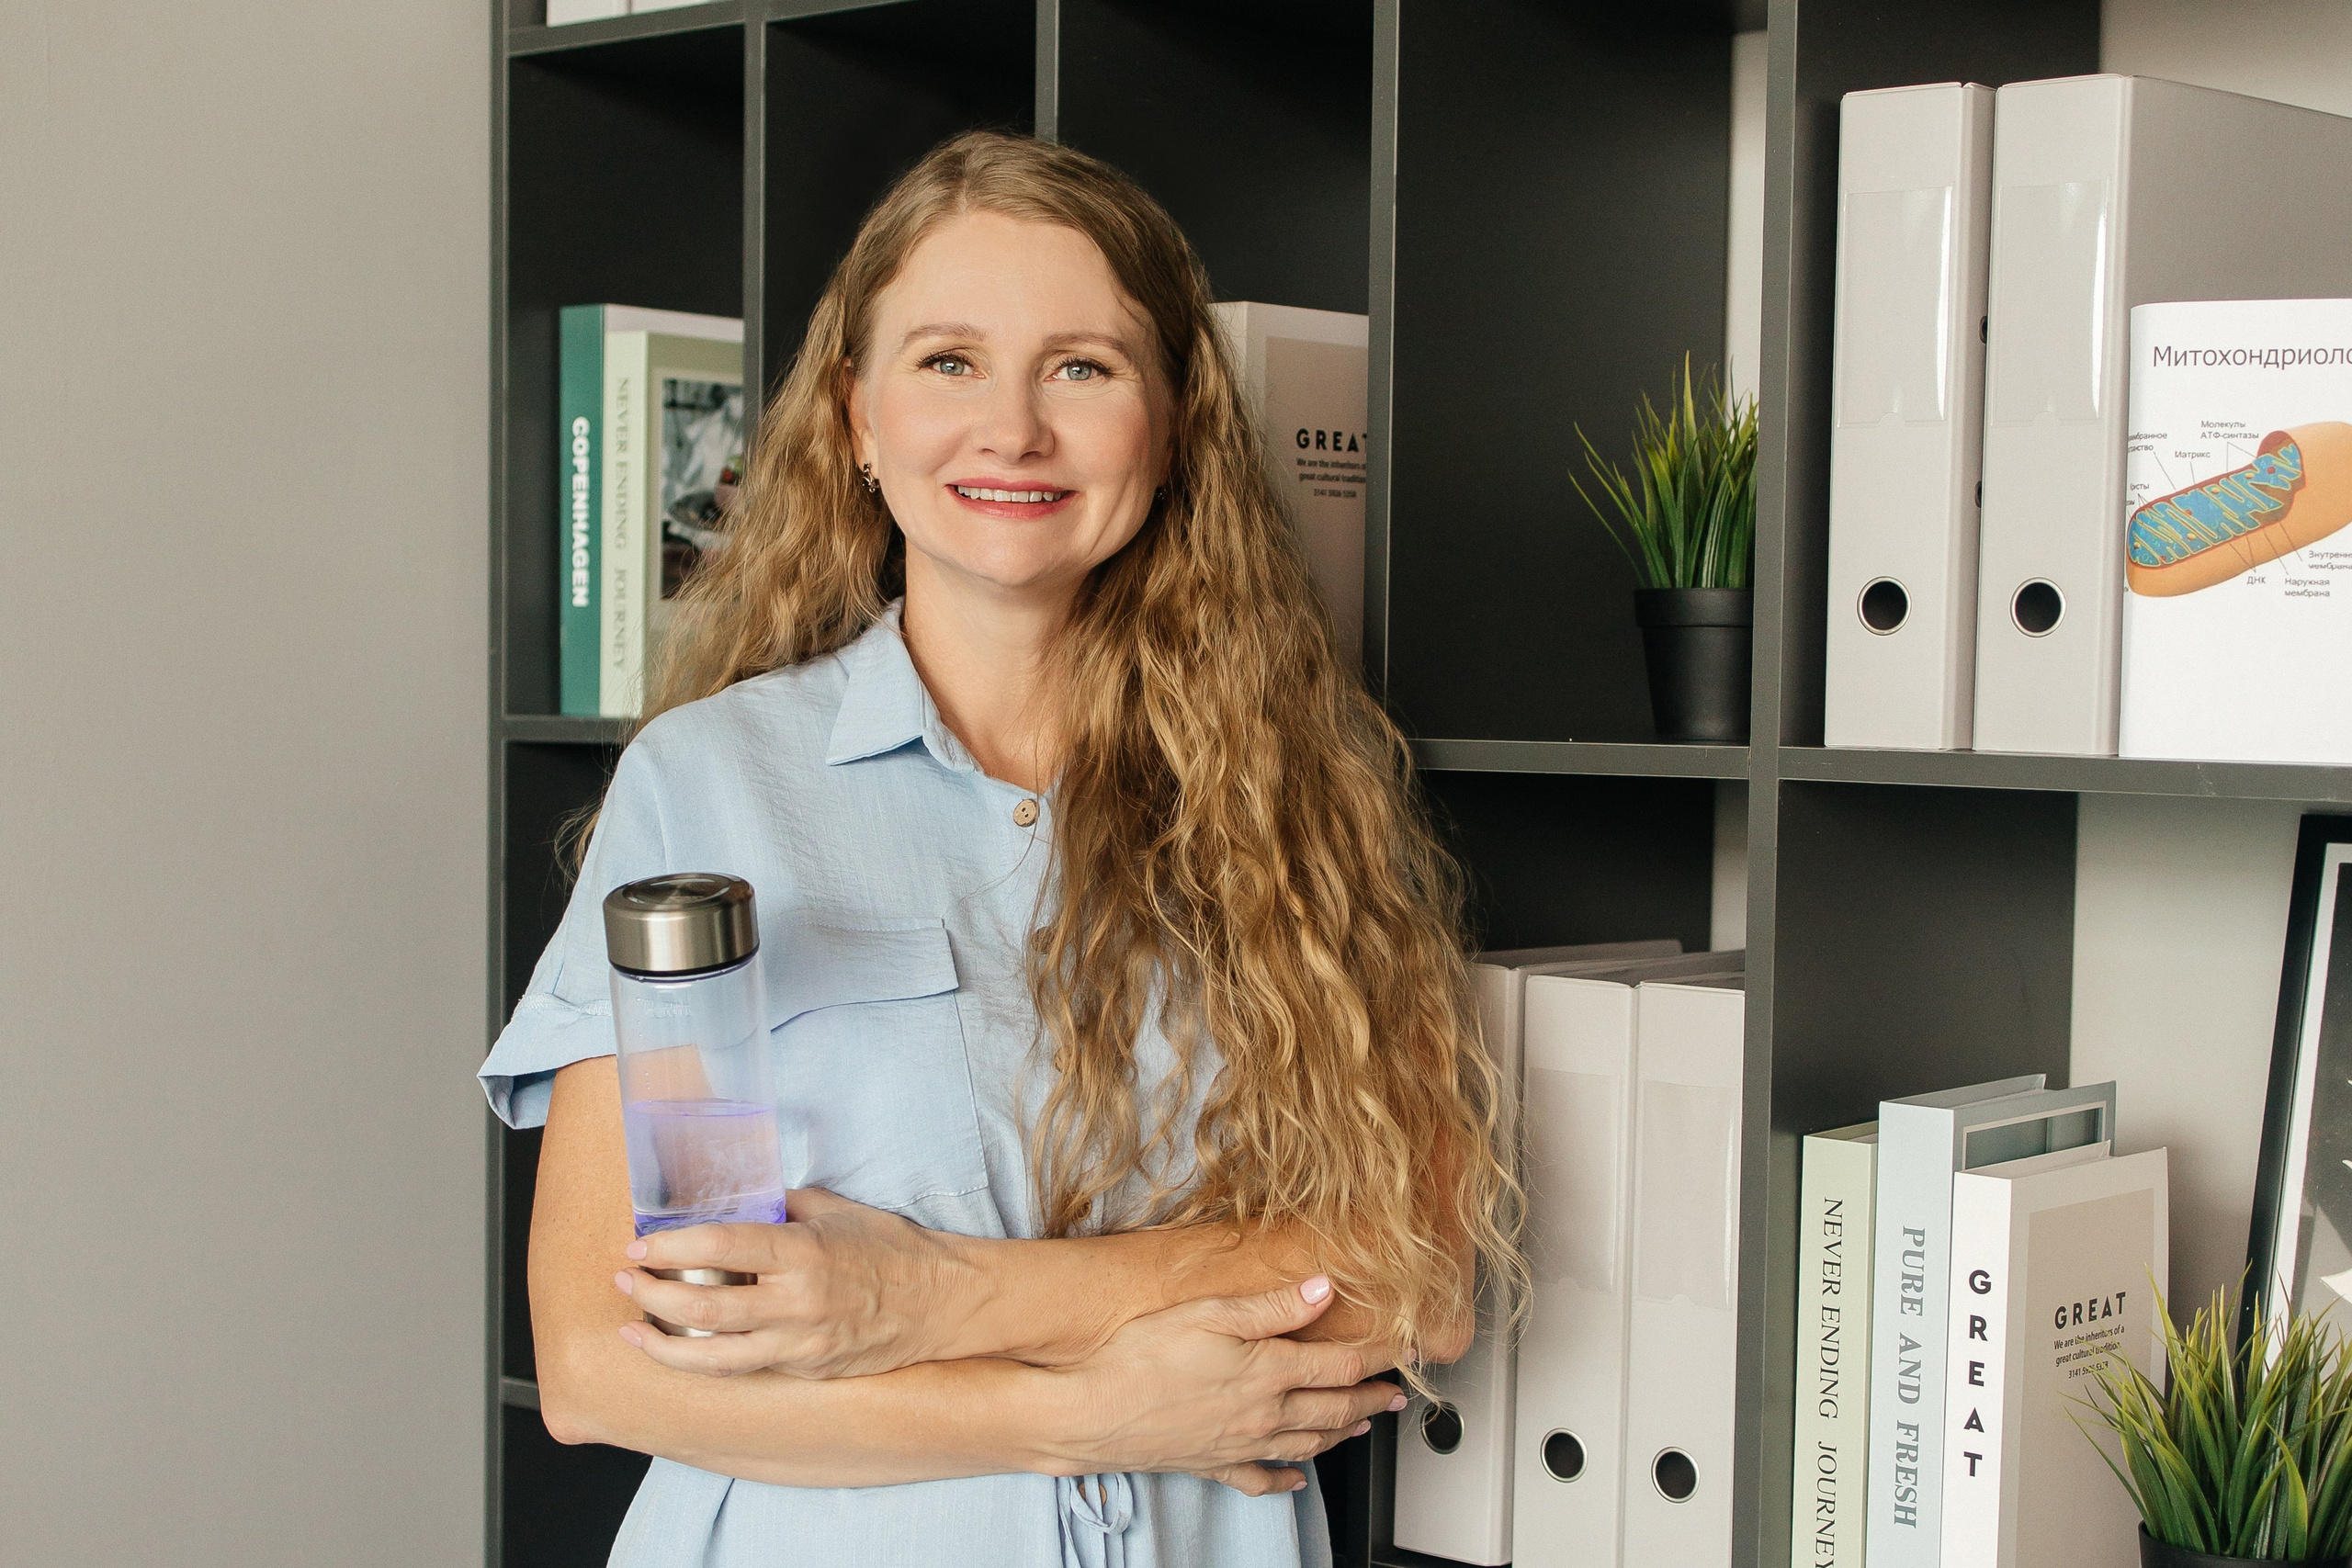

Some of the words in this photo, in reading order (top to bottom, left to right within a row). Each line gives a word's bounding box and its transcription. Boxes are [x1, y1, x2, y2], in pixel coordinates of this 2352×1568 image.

[616, 377, 630, 454] NEVER
[2200, 420, 2245, 429] Молекулы
[571, 416, 591, 607] COPENHAGEN
[615, 460, 629, 550] ENDING
[2246, 576, 2266, 585] ДНК
[2284, 589, 2330, 598] мембрана
[2285, 578, 2330, 587] Наружная
[1821, 1196, 1844, 1296] NEVER
[1899, 1225, 1926, 1317] PURE
[2053, 1340, 2064, 1349] We
[2064, 1338, 2074, 1348] are
[2113, 1324, 2120, 1335] of
[2054, 1292, 2126, 1329] GREAT
[1817, 1305, 1842, 1420] ENDING
[1896, 1332, 1922, 1405] AND
[1962, 1269, 1992, 1477] GREAT
[2055, 1353, 2072, 1367] great
[2068, 1369, 2081, 1379] 3141
[1894, 1419, 1920, 1529] FRESH
